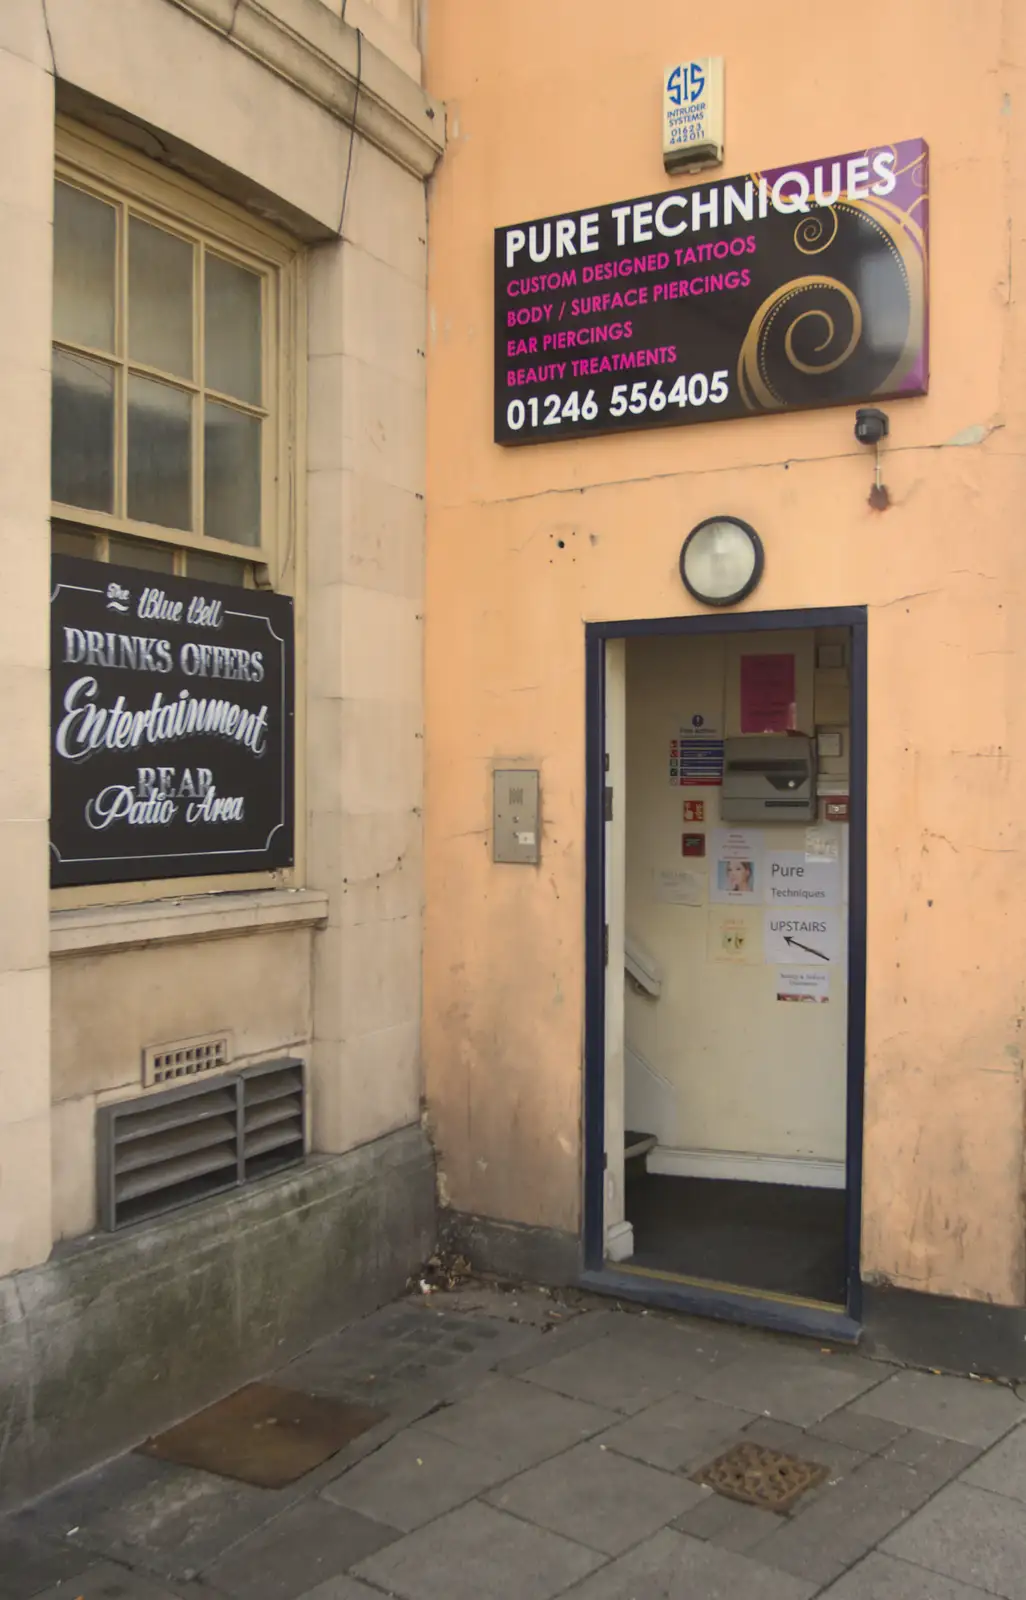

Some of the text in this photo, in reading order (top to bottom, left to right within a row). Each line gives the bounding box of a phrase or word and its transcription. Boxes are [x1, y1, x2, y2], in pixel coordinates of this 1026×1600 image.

[667, 62, 705, 105] SIS
[667, 102, 706, 118] INTRUDER
[669, 112, 704, 127] SYSTEMS
[506, 152, 897, 268] PURE TECHNIQUES
[507, 235, 757, 297] CUSTOM DESIGNED TATTOOS
[507, 268, 751, 328] BODY / SURFACE PIERCINGS
[507, 320, 633, 357] EAR PIERCINGS
[507, 345, 677, 387] BEAUTY TREATMENTS
[506, 370, 729, 431] 01246 556405
[137, 587, 184, 623] Blue
[186, 595, 223, 628] Bell
[63, 626, 265, 683] DRINKS OFFERS
[55, 675, 269, 760] Entertainment
[136, 767, 215, 799] REAR
[84, 784, 245, 830] Patio Area
[771, 864, 805, 877] Pure
[771, 888, 826, 899] Techniques
[770, 921, 827, 932] UPSTAIRS
